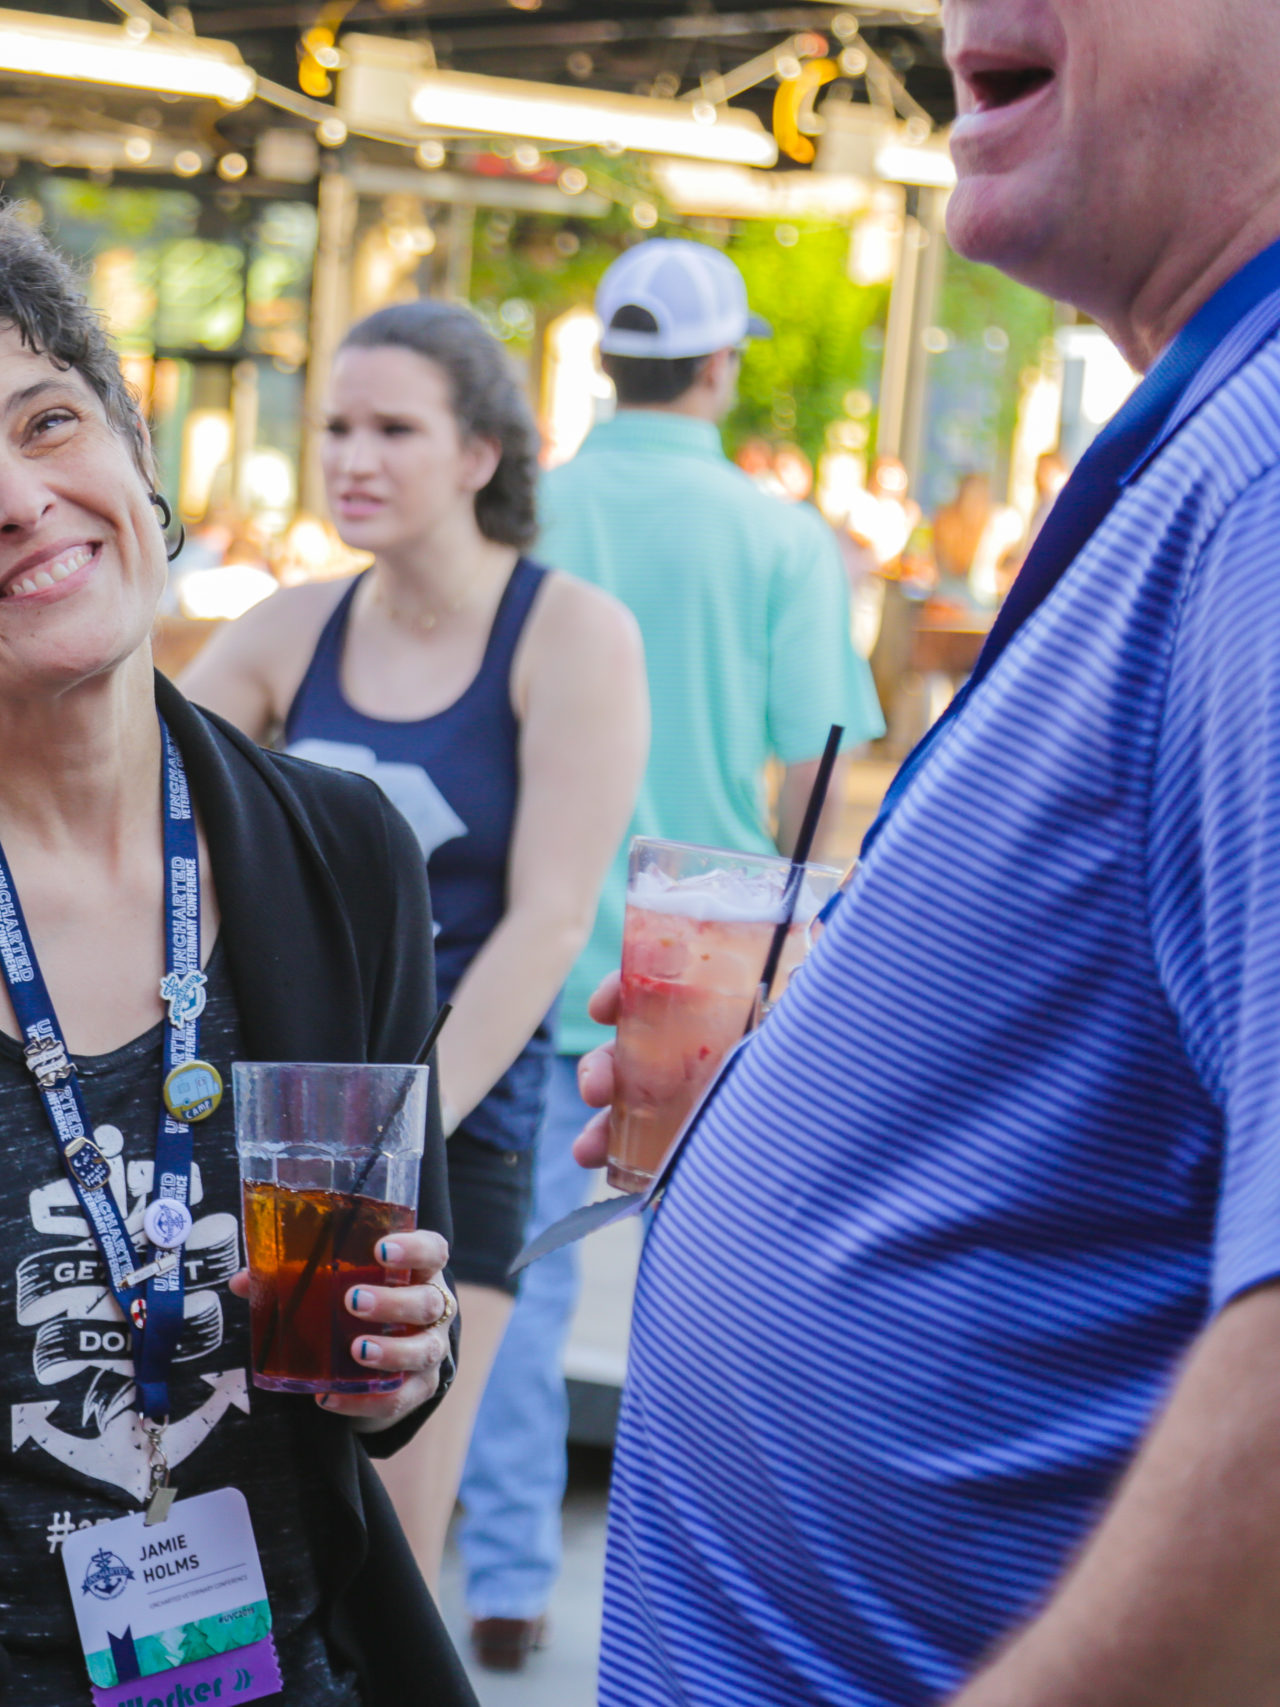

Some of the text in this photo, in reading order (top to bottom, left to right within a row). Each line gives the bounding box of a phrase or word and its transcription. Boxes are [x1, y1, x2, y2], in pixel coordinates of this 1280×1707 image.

[185, 858, 197, 917] CONFERENCE
[171, 856, 188, 975] UNCHARTED
[186, 1100, 210, 1119] CAMP
[78, 1184, 106, 1235] ETERINARY
[89, 1187, 135, 1276] NCHARTE
[53, 1260, 101, 1283] GE
[140, 1534, 187, 1561] JAMIE
[143, 1554, 199, 1583] HOLMS
